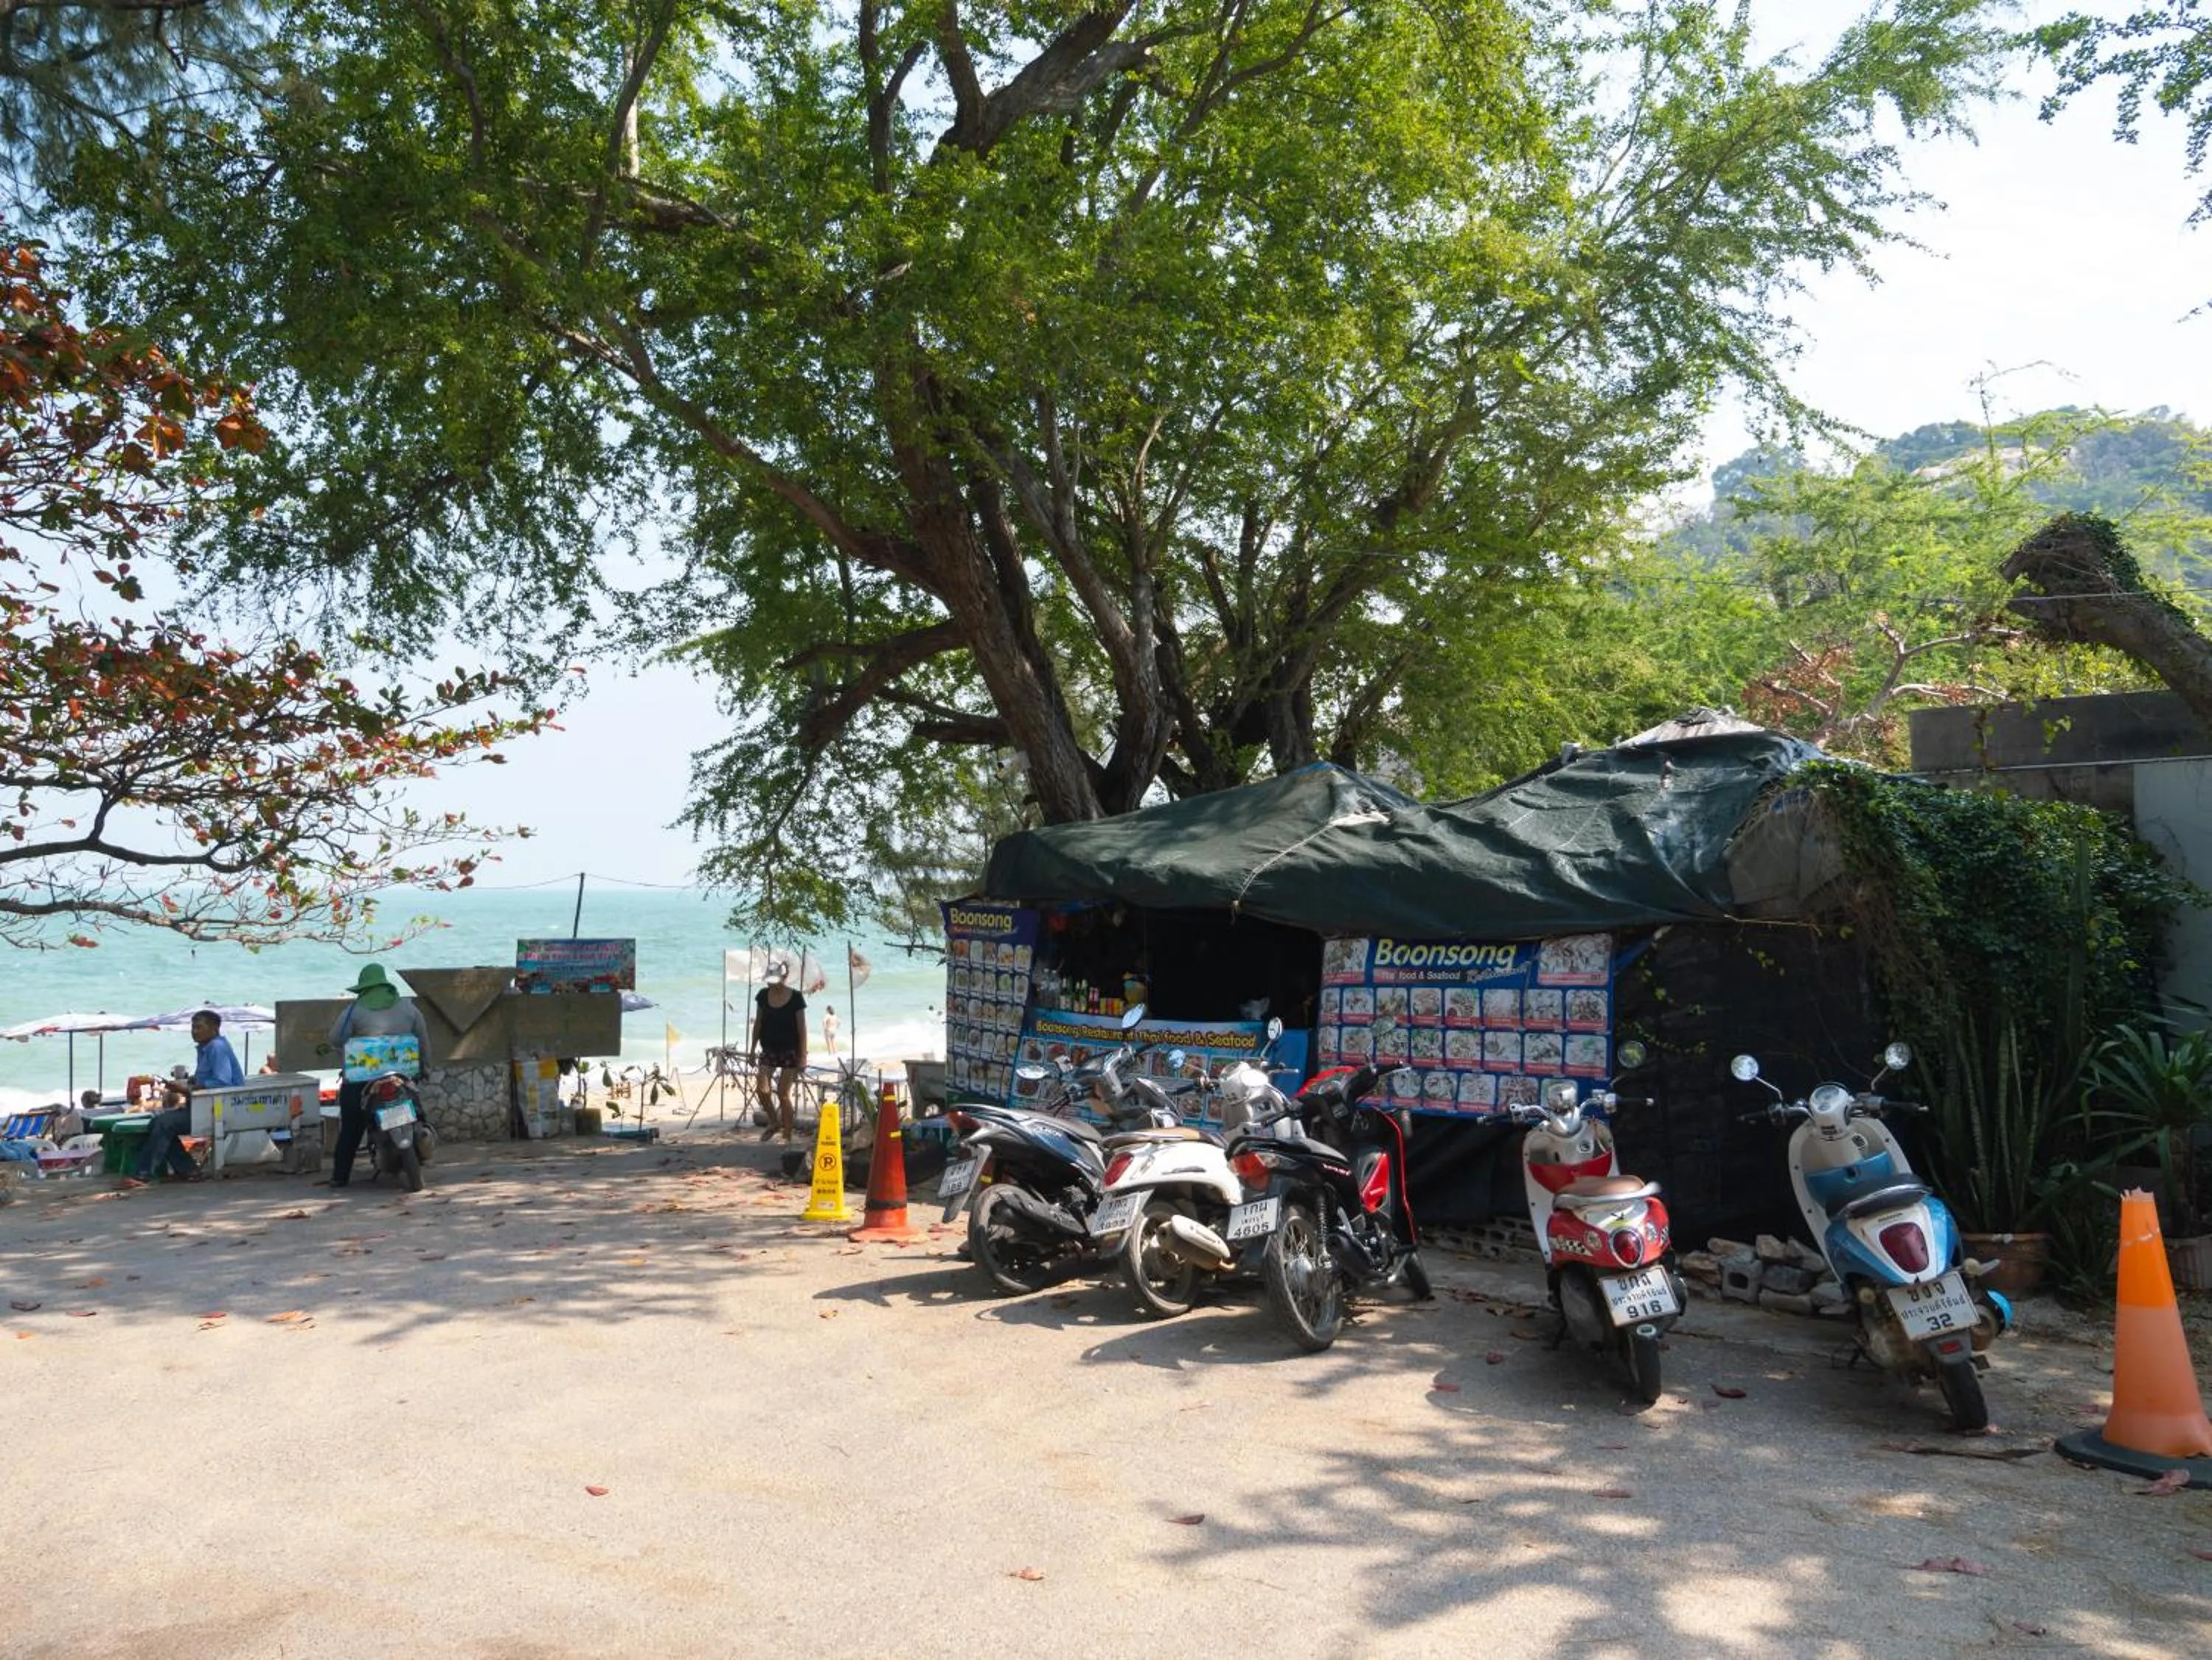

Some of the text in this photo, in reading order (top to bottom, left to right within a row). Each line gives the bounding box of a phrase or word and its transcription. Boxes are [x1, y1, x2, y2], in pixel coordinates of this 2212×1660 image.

[950, 907, 1012, 932] Boonsong
[1374, 938, 1517, 971] Boonsong
[1037, 1019, 1079, 1039] Boonsong
[1208, 1033, 1257, 1047] Seafood
[1234, 1221, 1269, 1238] 4605
[1627, 1300, 1663, 1319] 916
[1927, 1313, 1955, 1331] 32
